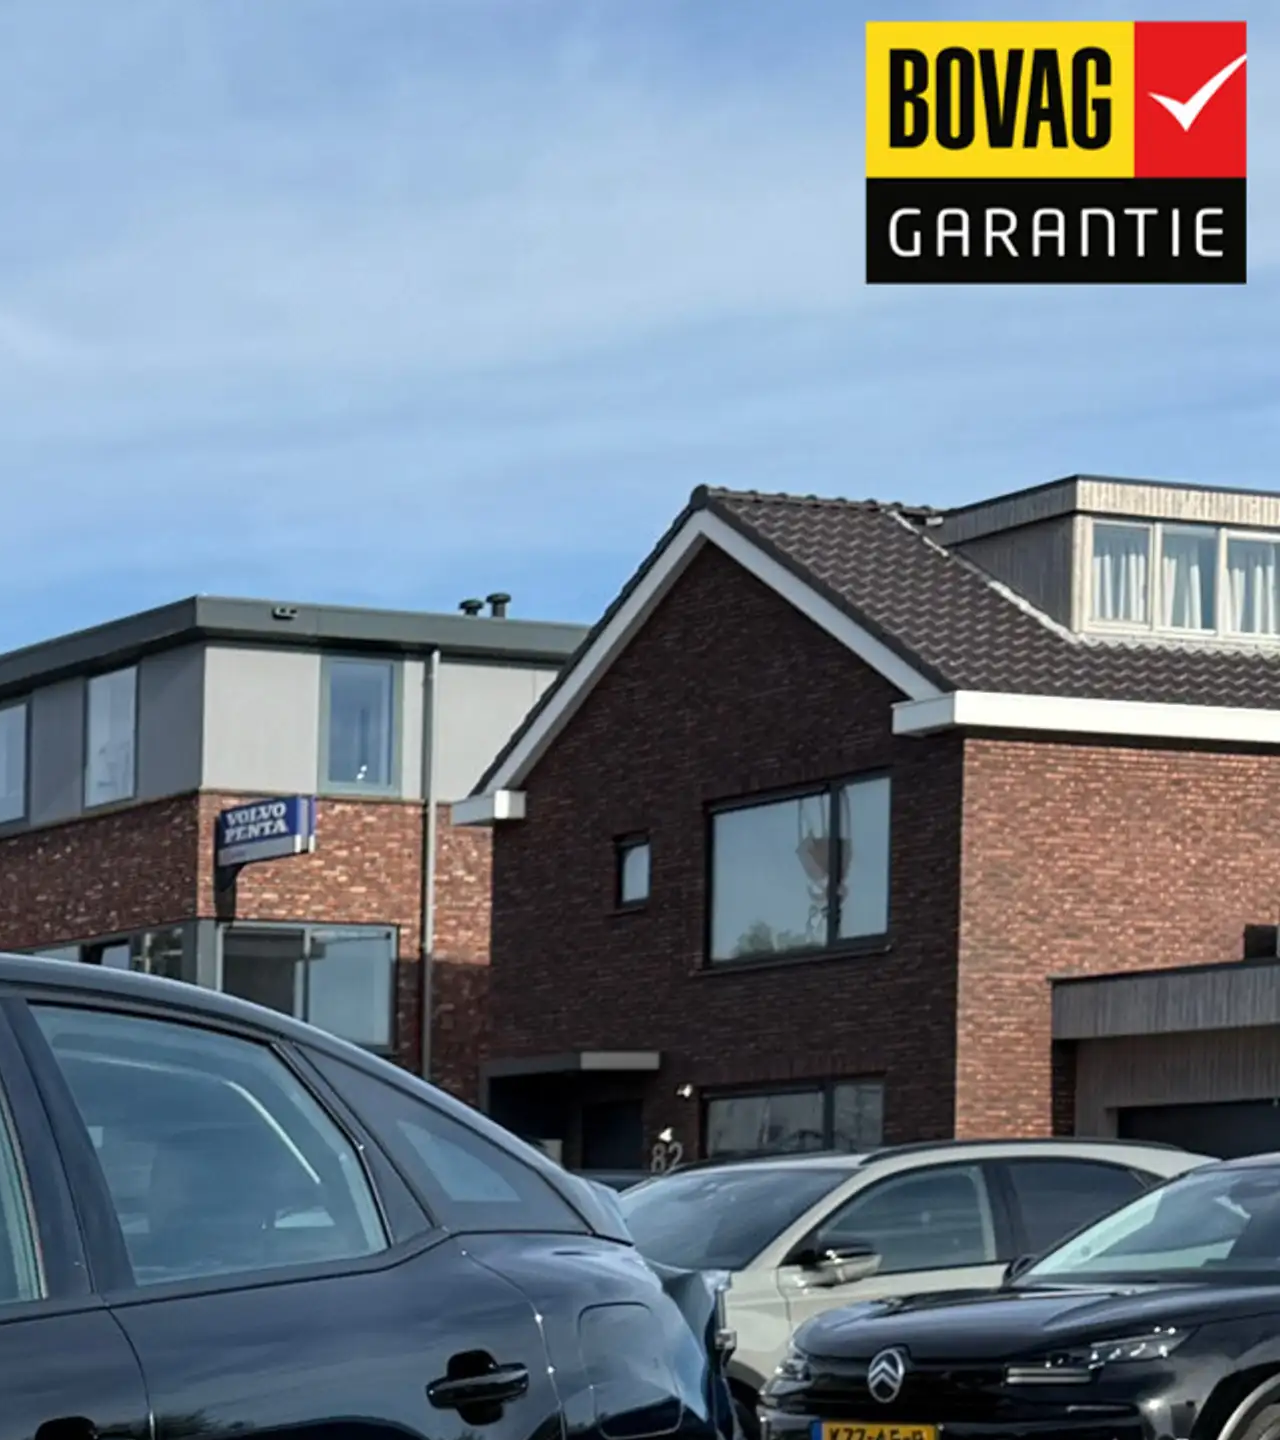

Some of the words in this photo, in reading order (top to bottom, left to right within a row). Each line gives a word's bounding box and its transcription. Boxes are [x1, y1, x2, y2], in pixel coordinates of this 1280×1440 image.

[227, 803, 286, 826] VOLVO
[225, 820, 287, 843] PENTA
[651, 1142, 682, 1175] 82
